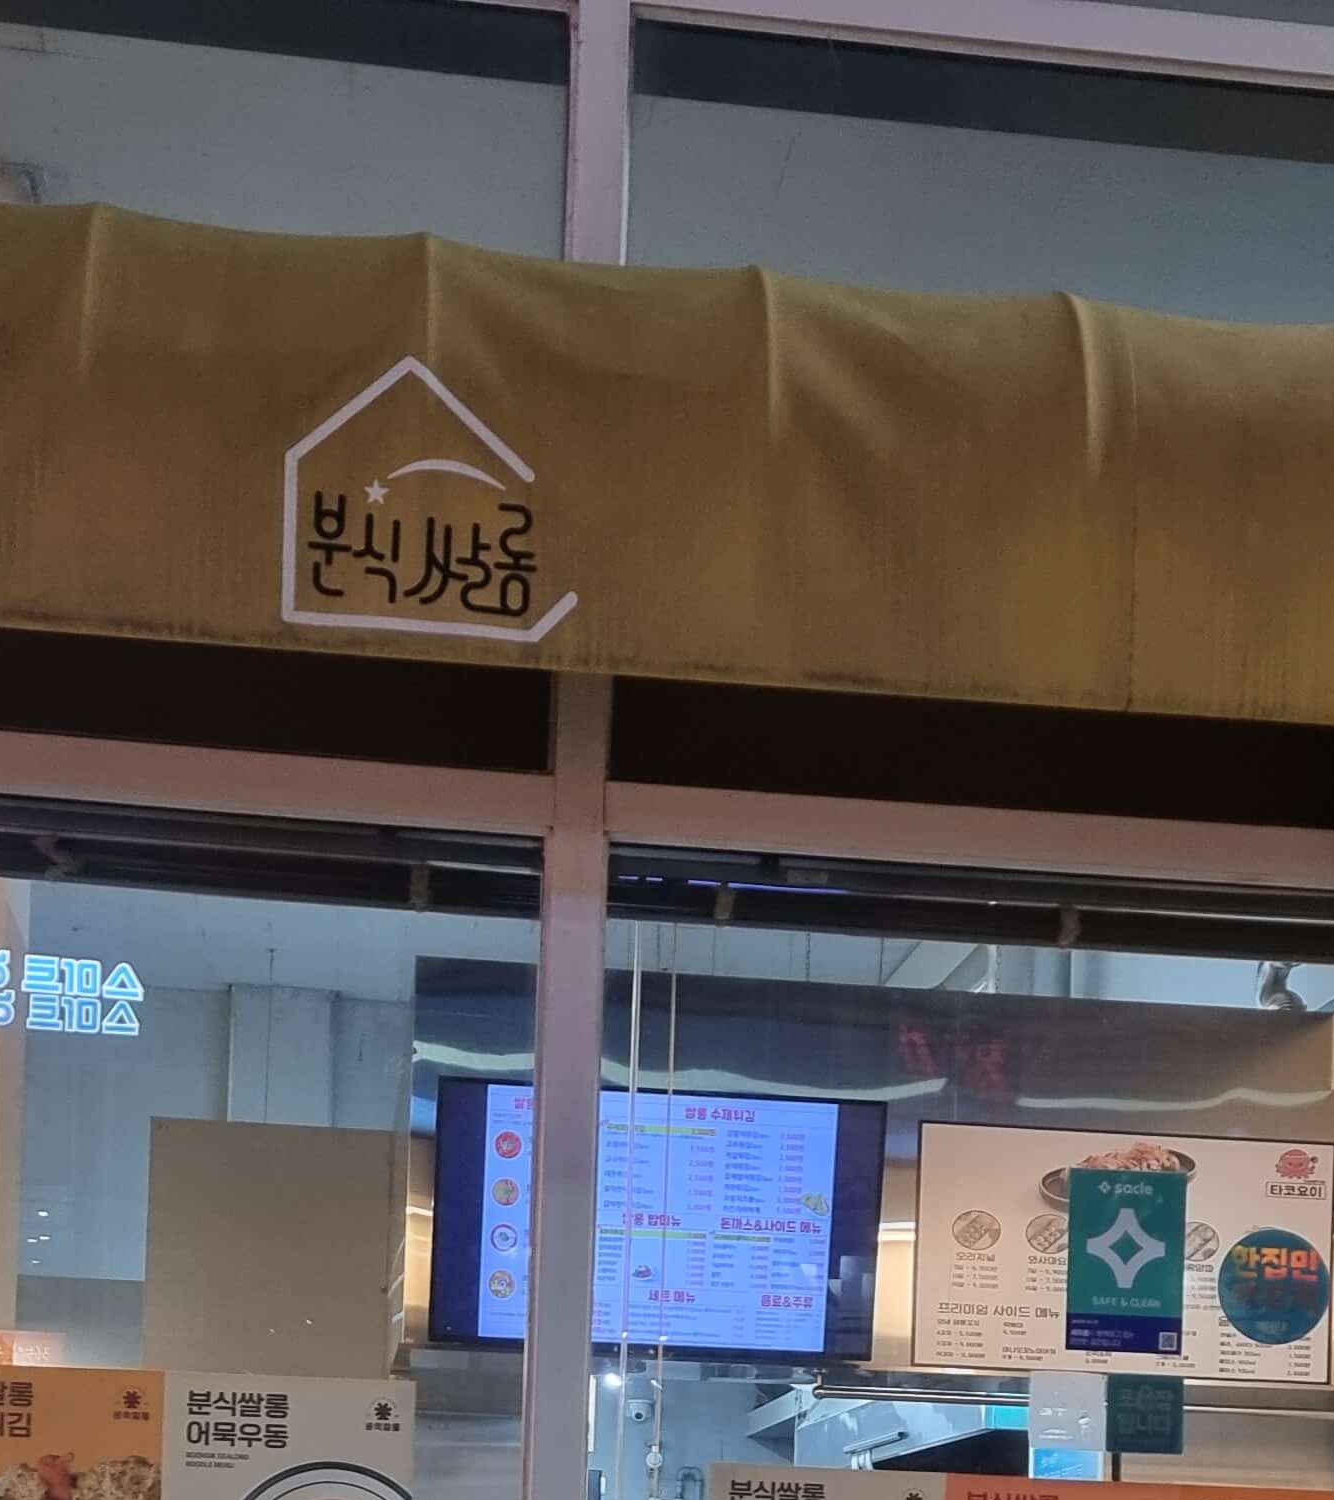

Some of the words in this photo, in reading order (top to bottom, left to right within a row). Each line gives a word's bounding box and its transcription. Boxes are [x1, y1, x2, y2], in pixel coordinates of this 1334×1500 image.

[308, 491, 536, 616] 분식쌀롱
[187, 1390, 290, 1419] 분식쌀롱
[186, 1421, 289, 1449] 어묵우동
